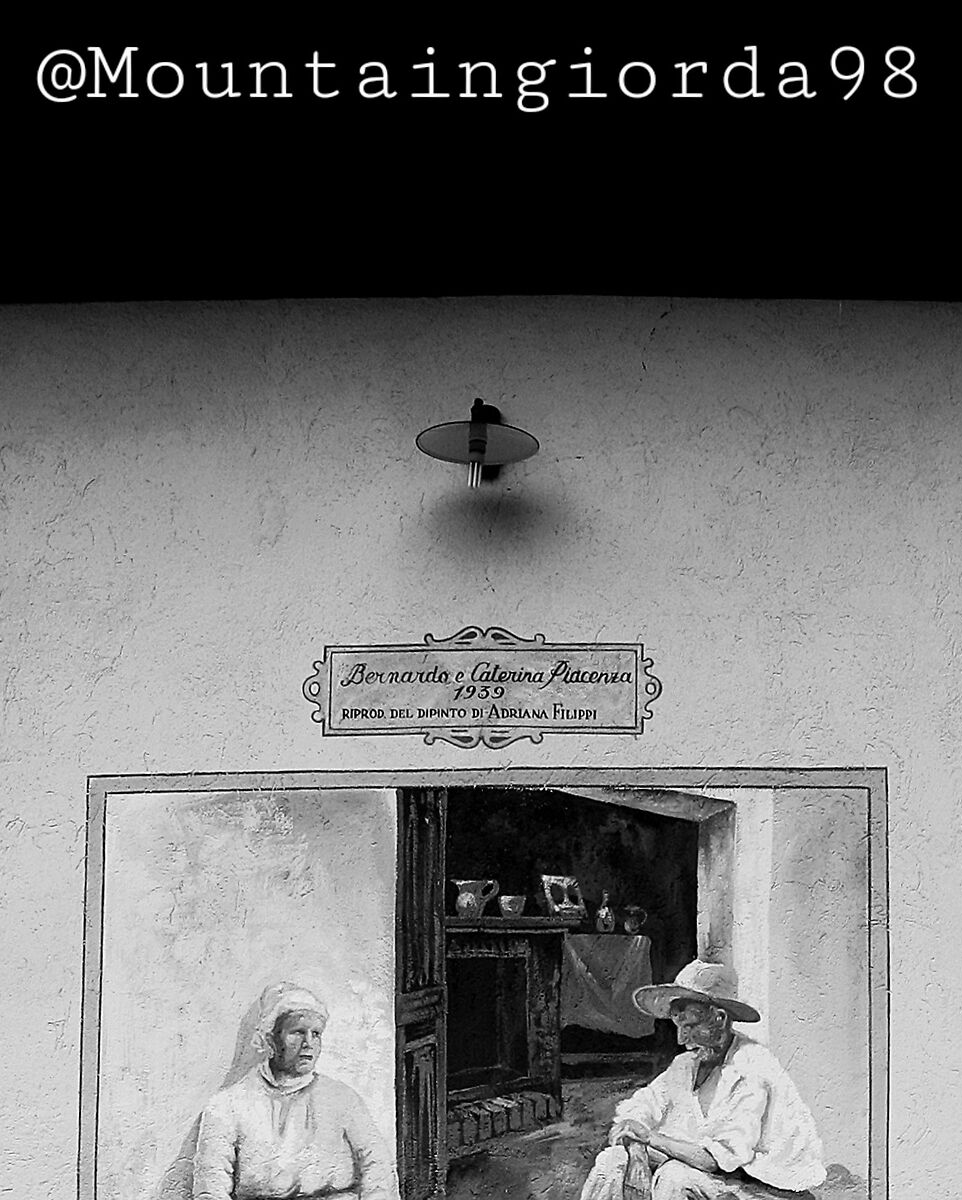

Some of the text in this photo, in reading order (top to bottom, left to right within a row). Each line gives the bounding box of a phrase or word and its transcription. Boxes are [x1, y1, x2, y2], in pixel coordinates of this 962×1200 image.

[340, 660, 633, 690] Bernardo e Caterina Piacenza
[453, 685, 506, 701] 1939
[342, 708, 387, 720] RIPROD.
[390, 708, 414, 719] DEL
[417, 707, 467, 719] DIPINTO
[488, 703, 549, 720] ADRIANA
[553, 702, 598, 720] FILIPPI
